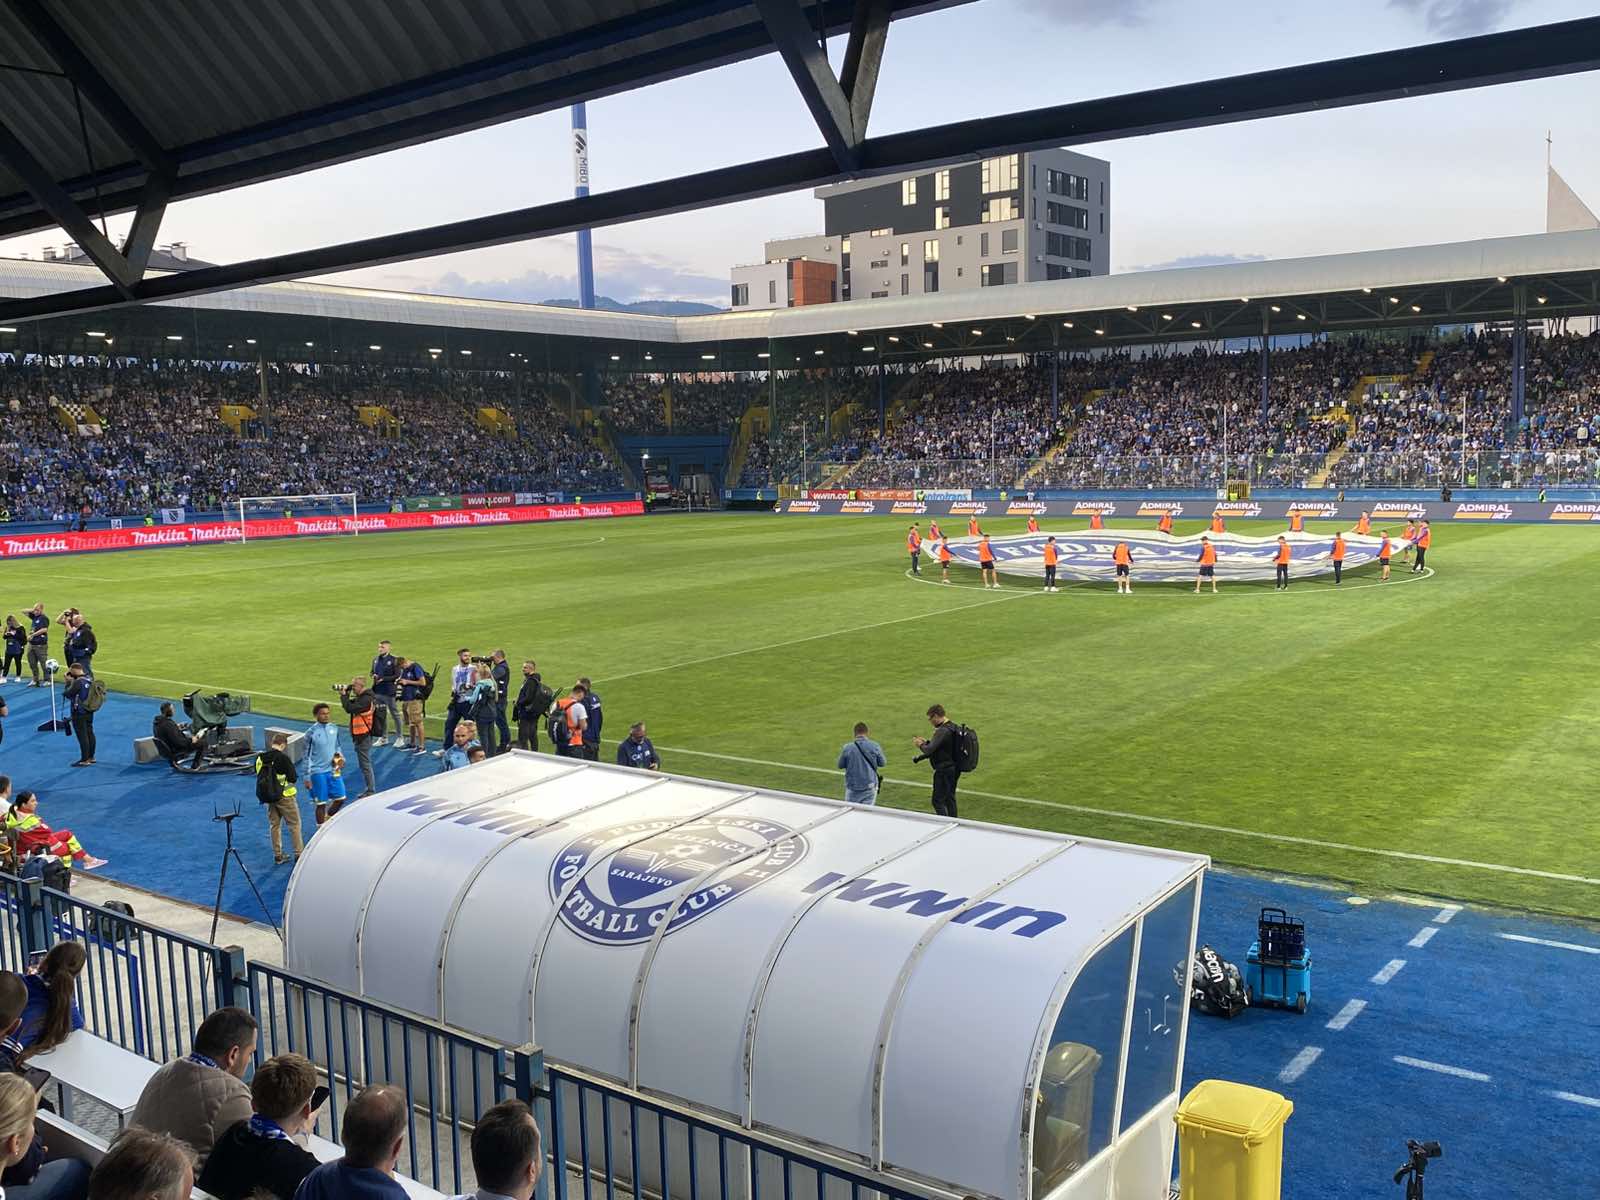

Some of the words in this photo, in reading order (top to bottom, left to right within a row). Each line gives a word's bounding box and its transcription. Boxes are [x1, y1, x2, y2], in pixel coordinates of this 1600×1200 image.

[1075, 502, 1116, 510] ADMIRAL
[1140, 502, 1184, 510] ADMIRAL
[1215, 502, 1262, 511] ADMIRAL
[1289, 502, 1339, 511] ADMIRAL
[1374, 503, 1427, 512] ADMIRAL
[1456, 503, 1513, 513] ADMIRAL
[610, 867, 674, 887] SARAJEVO
[801, 871, 1067, 938] wwin
